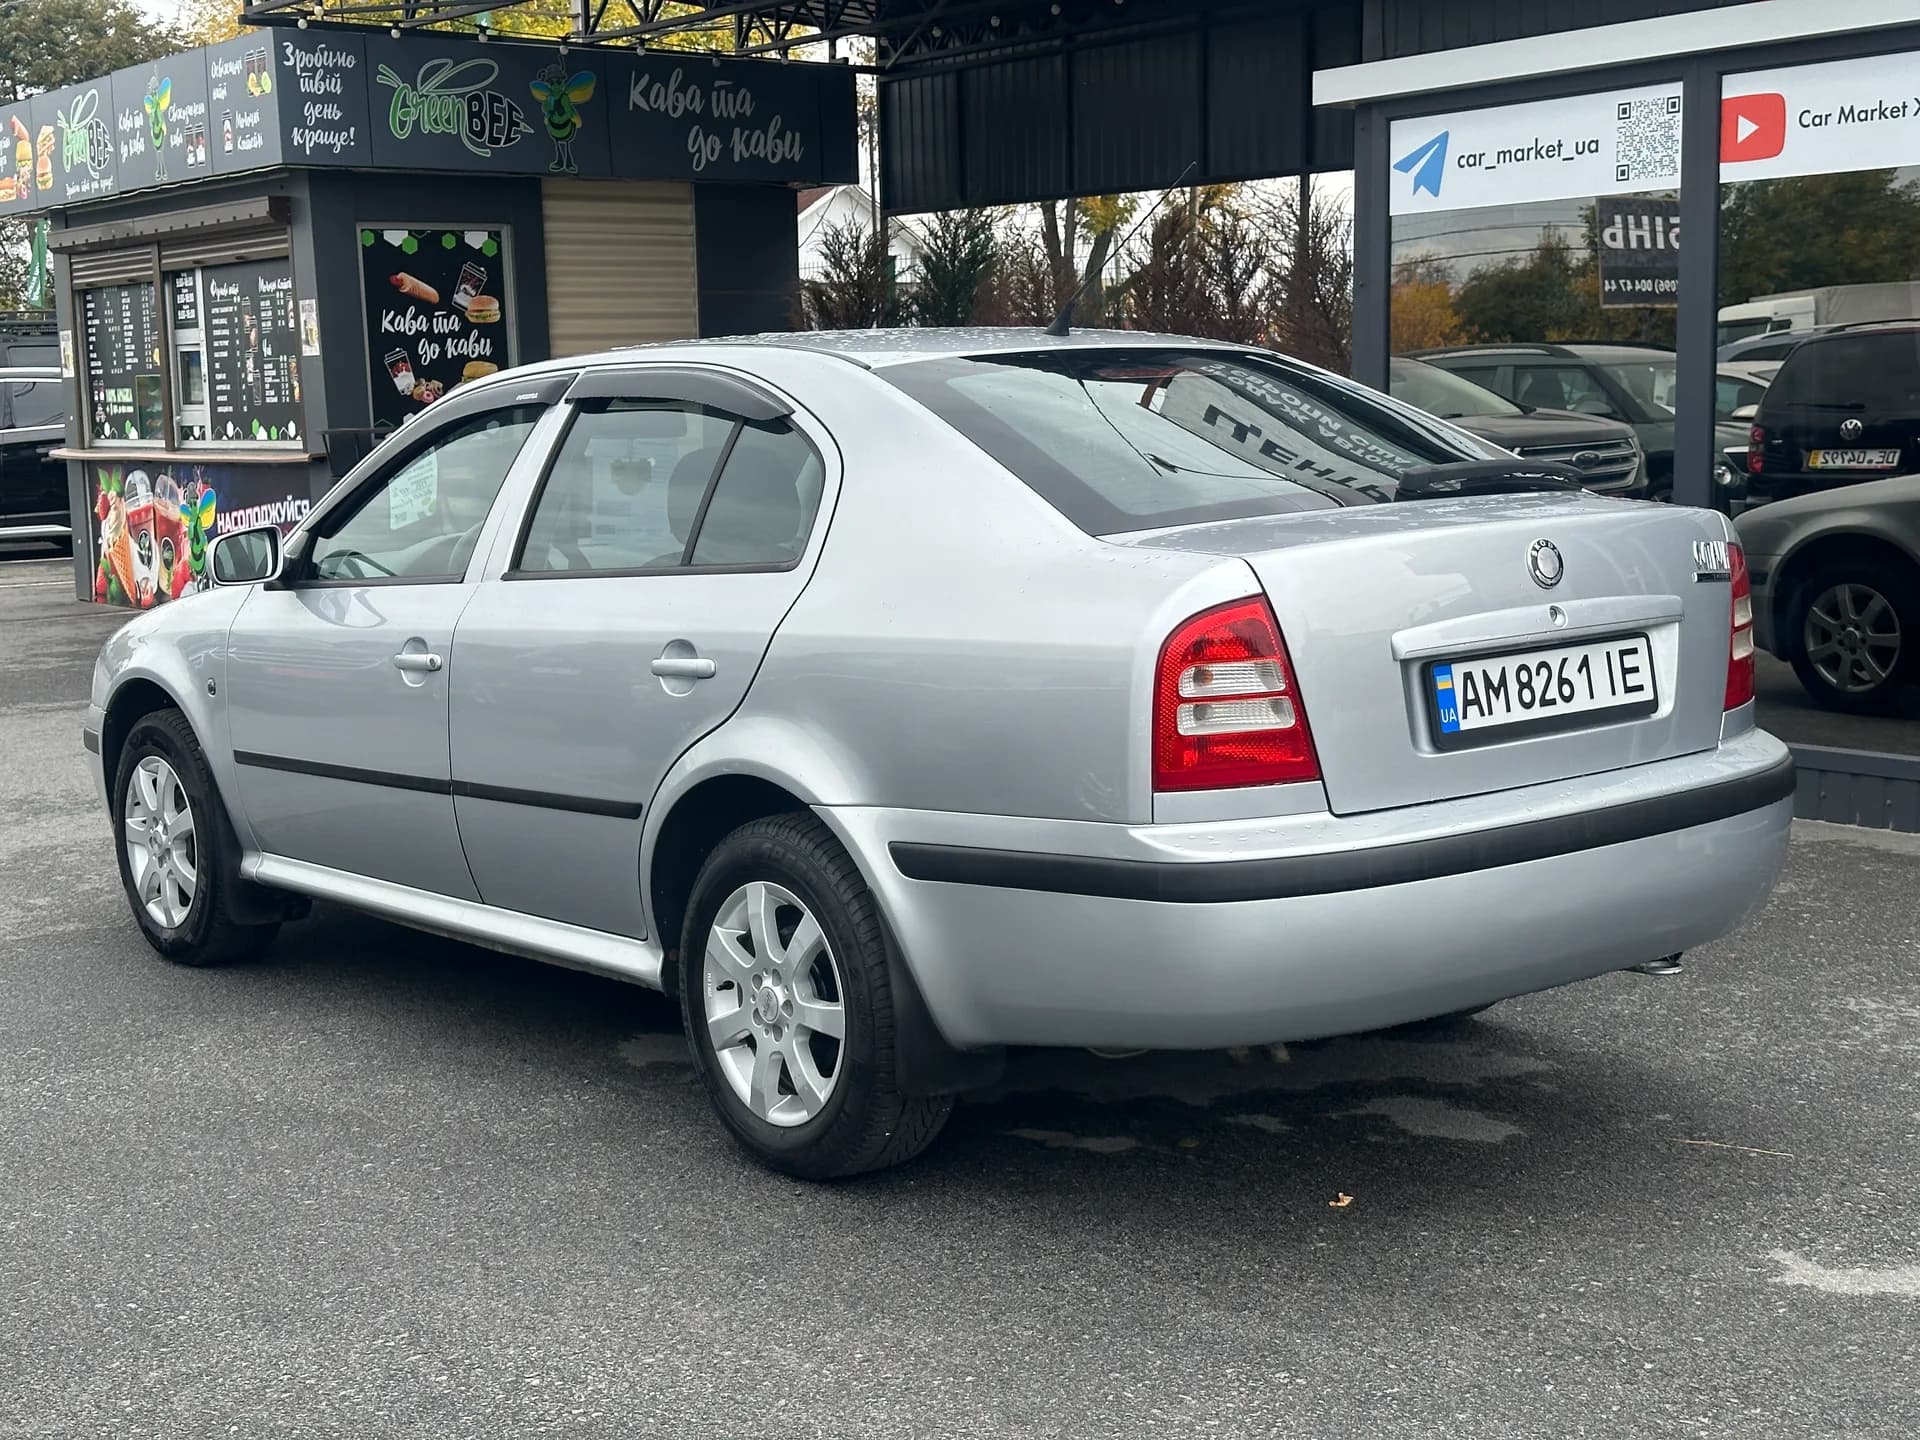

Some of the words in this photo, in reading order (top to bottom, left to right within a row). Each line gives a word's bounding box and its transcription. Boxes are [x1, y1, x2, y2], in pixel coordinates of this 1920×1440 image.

[282, 41, 356, 75] Зробимо
[300, 68, 343, 95] твій
[629, 67, 704, 118] Кава
[711, 80, 756, 119] та
[303, 101, 343, 126] день
[1799, 109, 1832, 128] Car
[1837, 99, 1908, 124] Market
[291, 126, 355, 155] краще!
[687, 125, 723, 171] до
[730, 114, 804, 164] кави
[1457, 138, 1599, 170] car_market_ua
[381, 305, 429, 335] Кава
[432, 311, 461, 334] та
[417, 338, 440, 366] до
[445, 329, 493, 359] кави
[217, 495, 310, 534] НАСОЛОДЖУЙСЯ
[1441, 707, 1457, 723] UA
